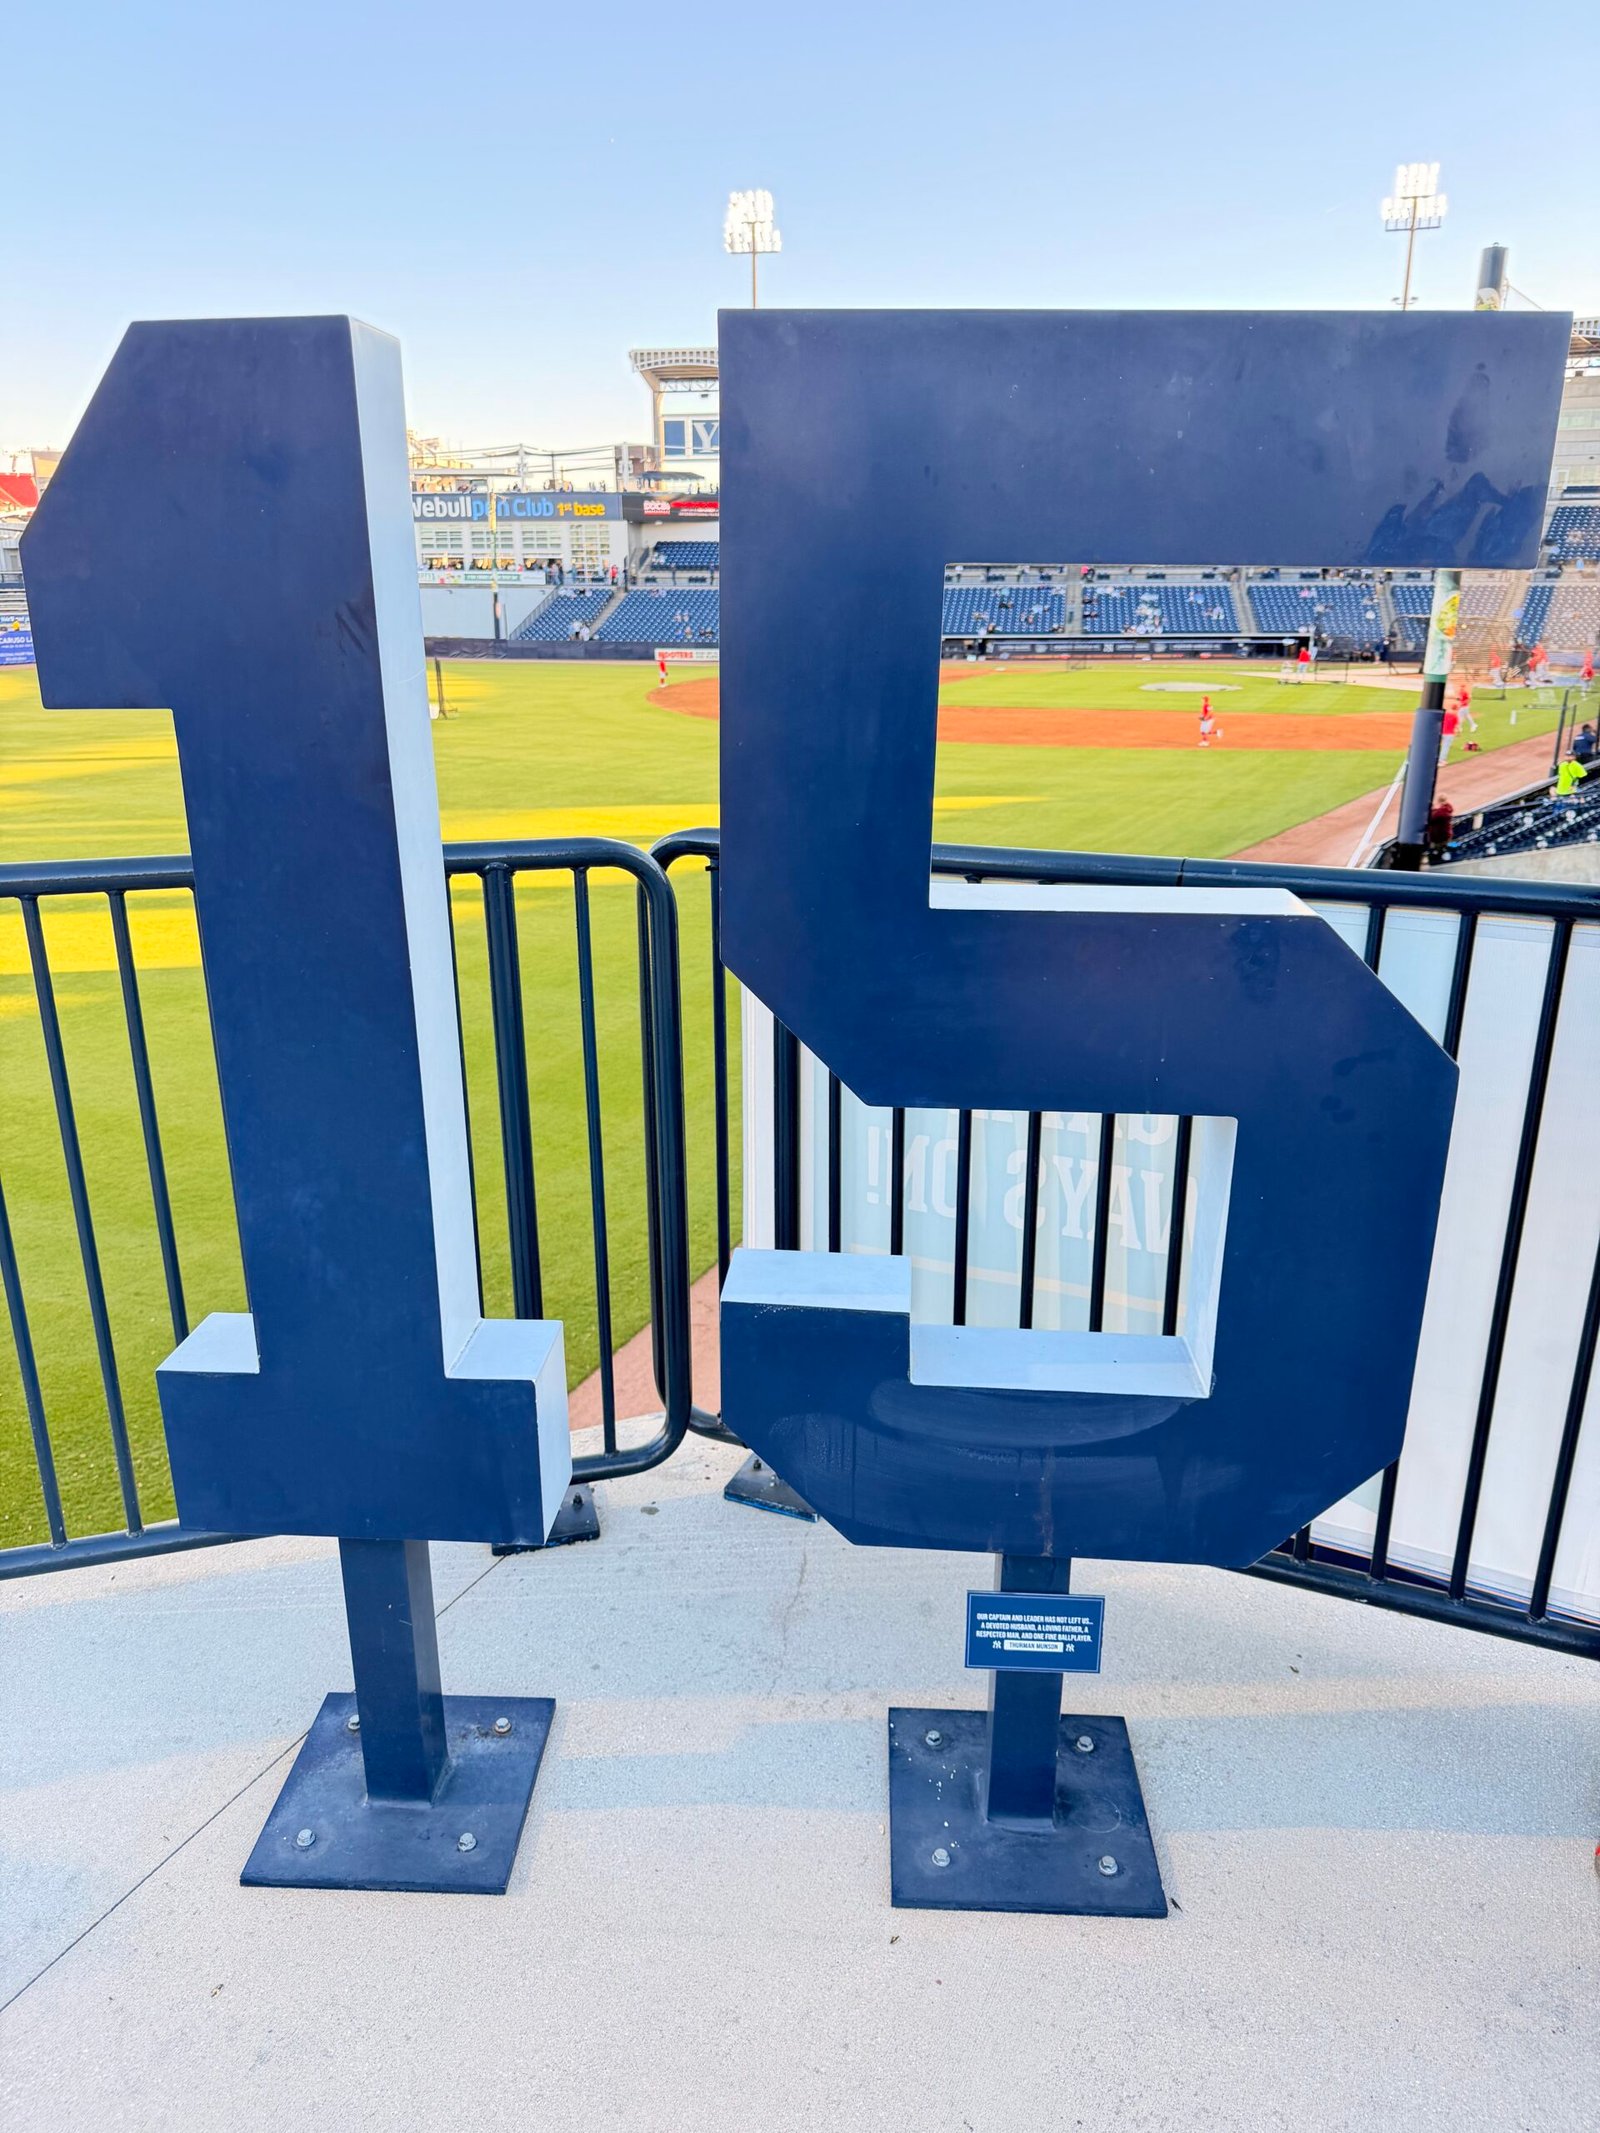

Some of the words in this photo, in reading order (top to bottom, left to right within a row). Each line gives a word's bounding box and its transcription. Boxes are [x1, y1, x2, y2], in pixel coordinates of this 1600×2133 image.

[513, 496, 554, 517] Club
[557, 502, 572, 516] 1st
[573, 501, 605, 516] base
[20, 310, 1572, 1570] 15
[1067, 1617, 1081, 1625] LEFT
[1010, 1624, 1036, 1632] HUSBAND,
[1062, 1626, 1083, 1634] FATHER,
[1006, 1632, 1020, 1640] MAN,
[1009, 1641, 1035, 1649] THURMAN
[1036, 1642, 1059, 1650] MUNSON
